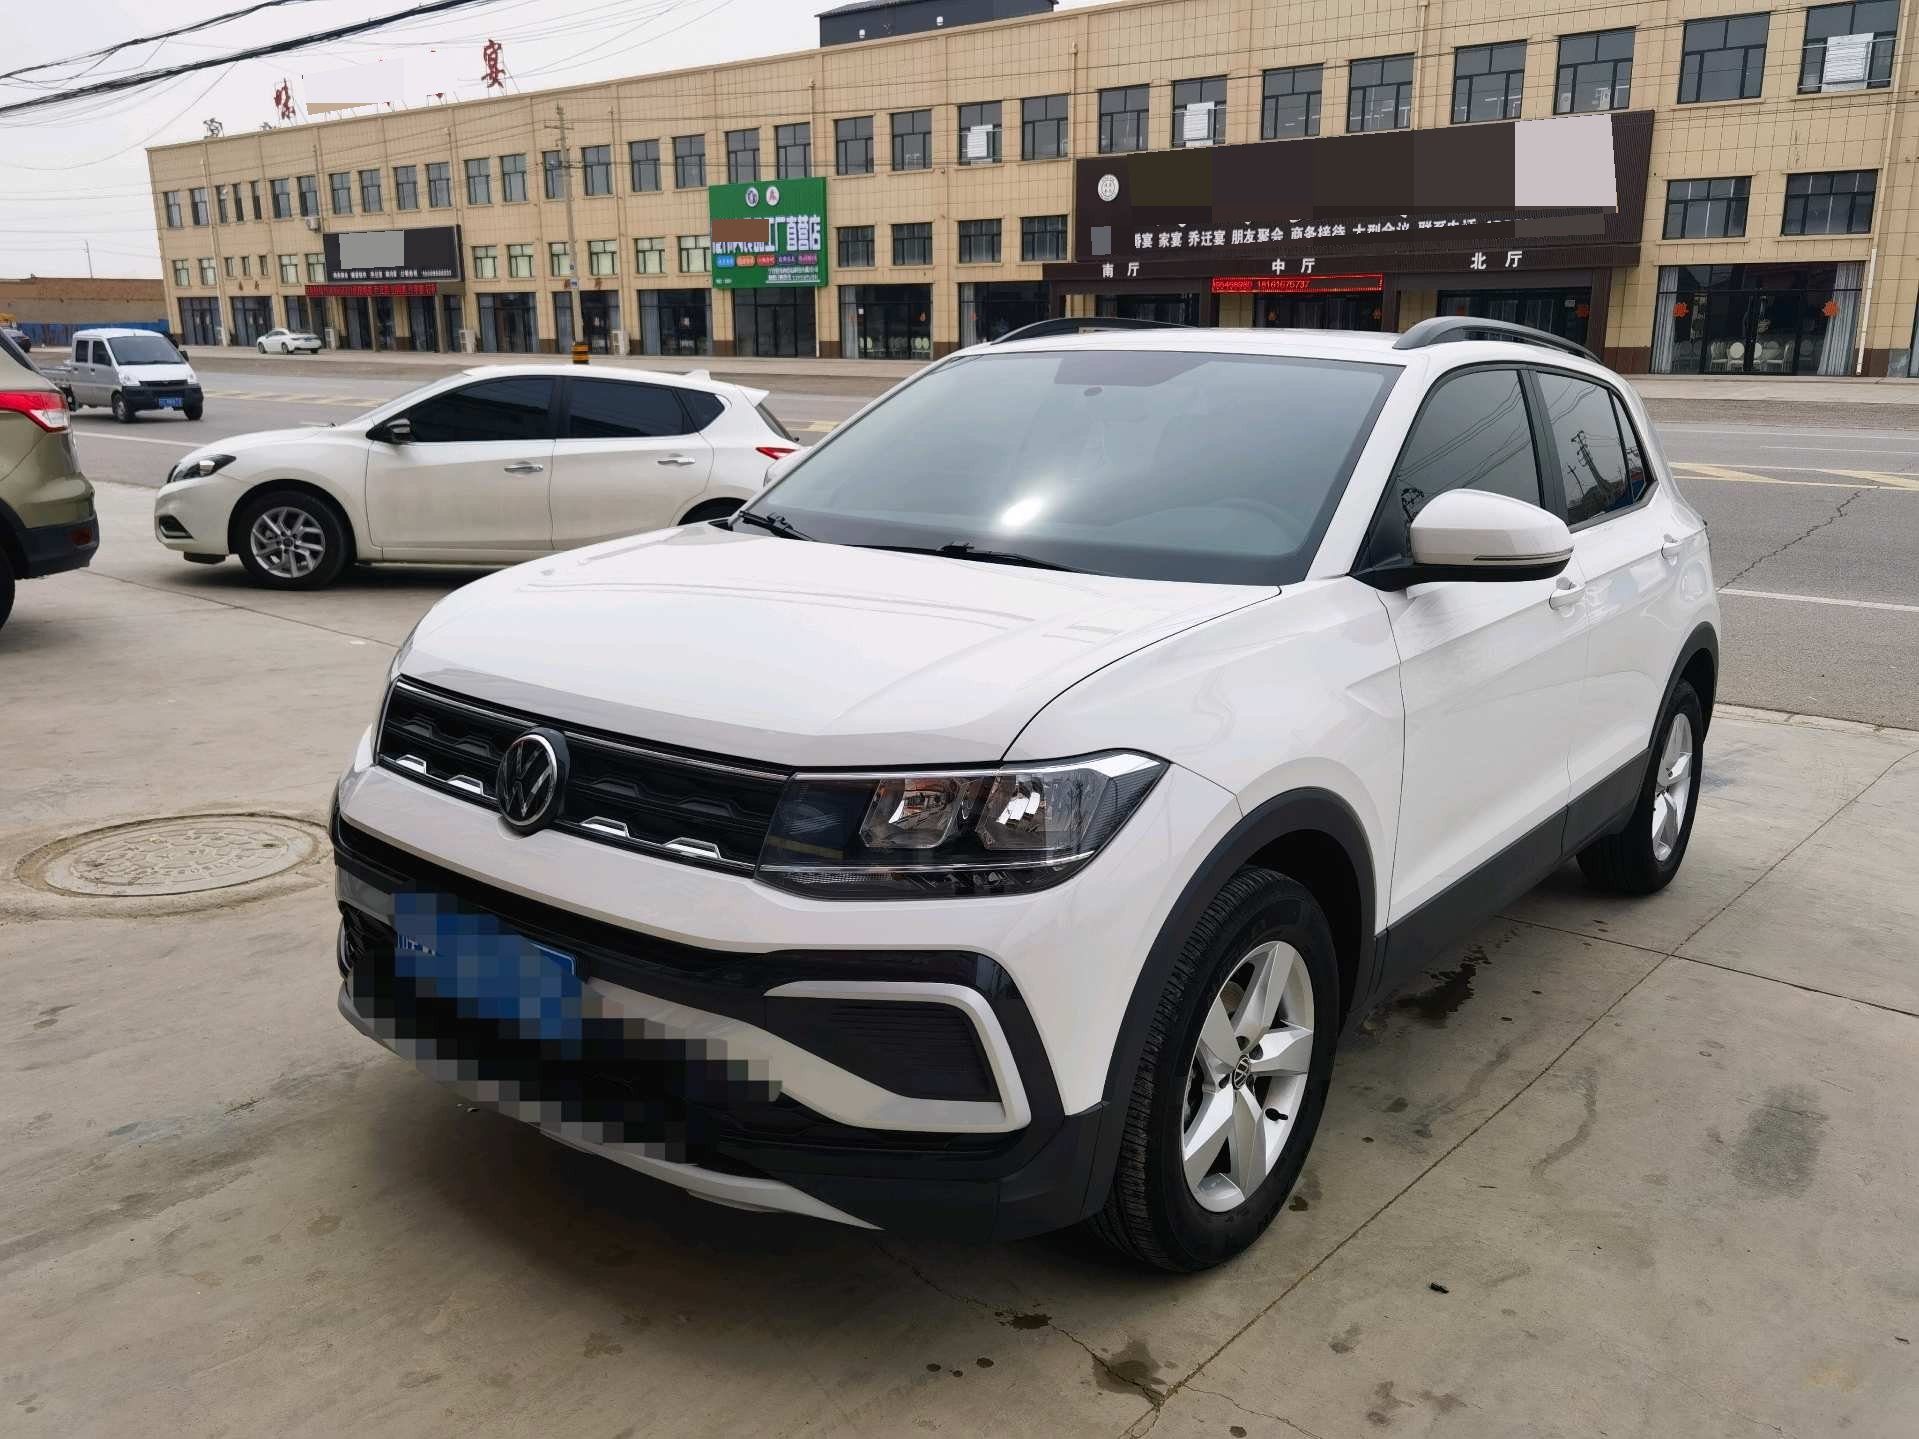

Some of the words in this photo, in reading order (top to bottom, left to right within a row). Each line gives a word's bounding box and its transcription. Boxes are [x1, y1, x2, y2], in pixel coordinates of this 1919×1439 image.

[1158, 231, 1183, 248] 家宴
[1188, 230, 1226, 247] 乔迁宴
[1231, 227, 1284, 244] 朋友聚会
[1271, 258, 1316, 275] 中厅
[1470, 250, 1523, 270] 北厅
[1101, 261, 1140, 278] 南厅
